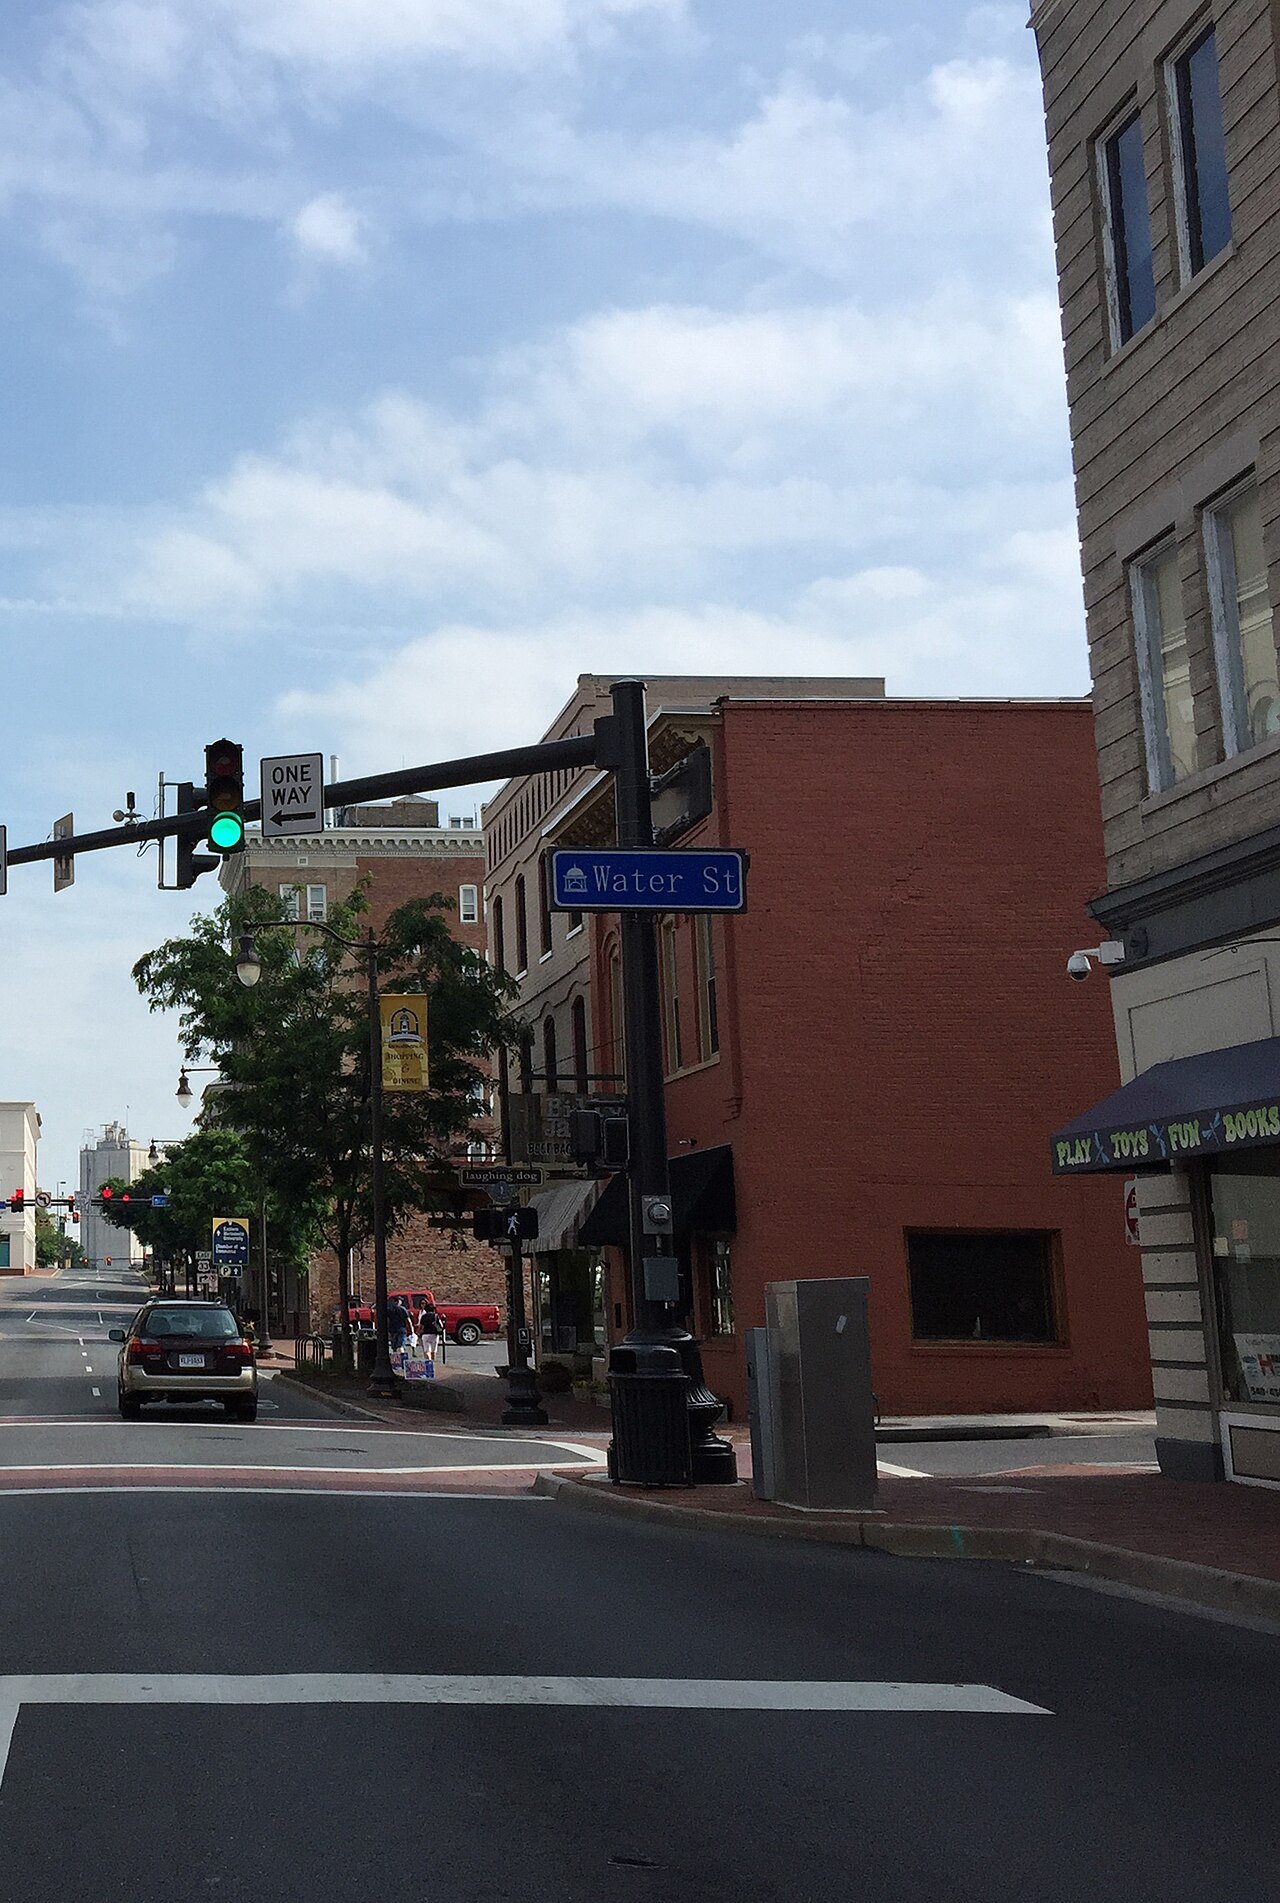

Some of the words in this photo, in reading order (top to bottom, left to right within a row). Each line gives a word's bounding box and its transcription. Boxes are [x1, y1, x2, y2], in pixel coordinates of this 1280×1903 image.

[272, 764, 311, 784] ONE
[271, 786, 312, 806] WAY
[592, 865, 683, 893] Water
[702, 866, 738, 893] St
[1056, 1138, 1092, 1167] PLAY
[1110, 1129, 1149, 1158] TOYS
[1168, 1119, 1202, 1151] FUN
[1222, 1105, 1280, 1142] BOOKS
[465, 1170, 514, 1182] laughing
[516, 1171, 538, 1182] dog
